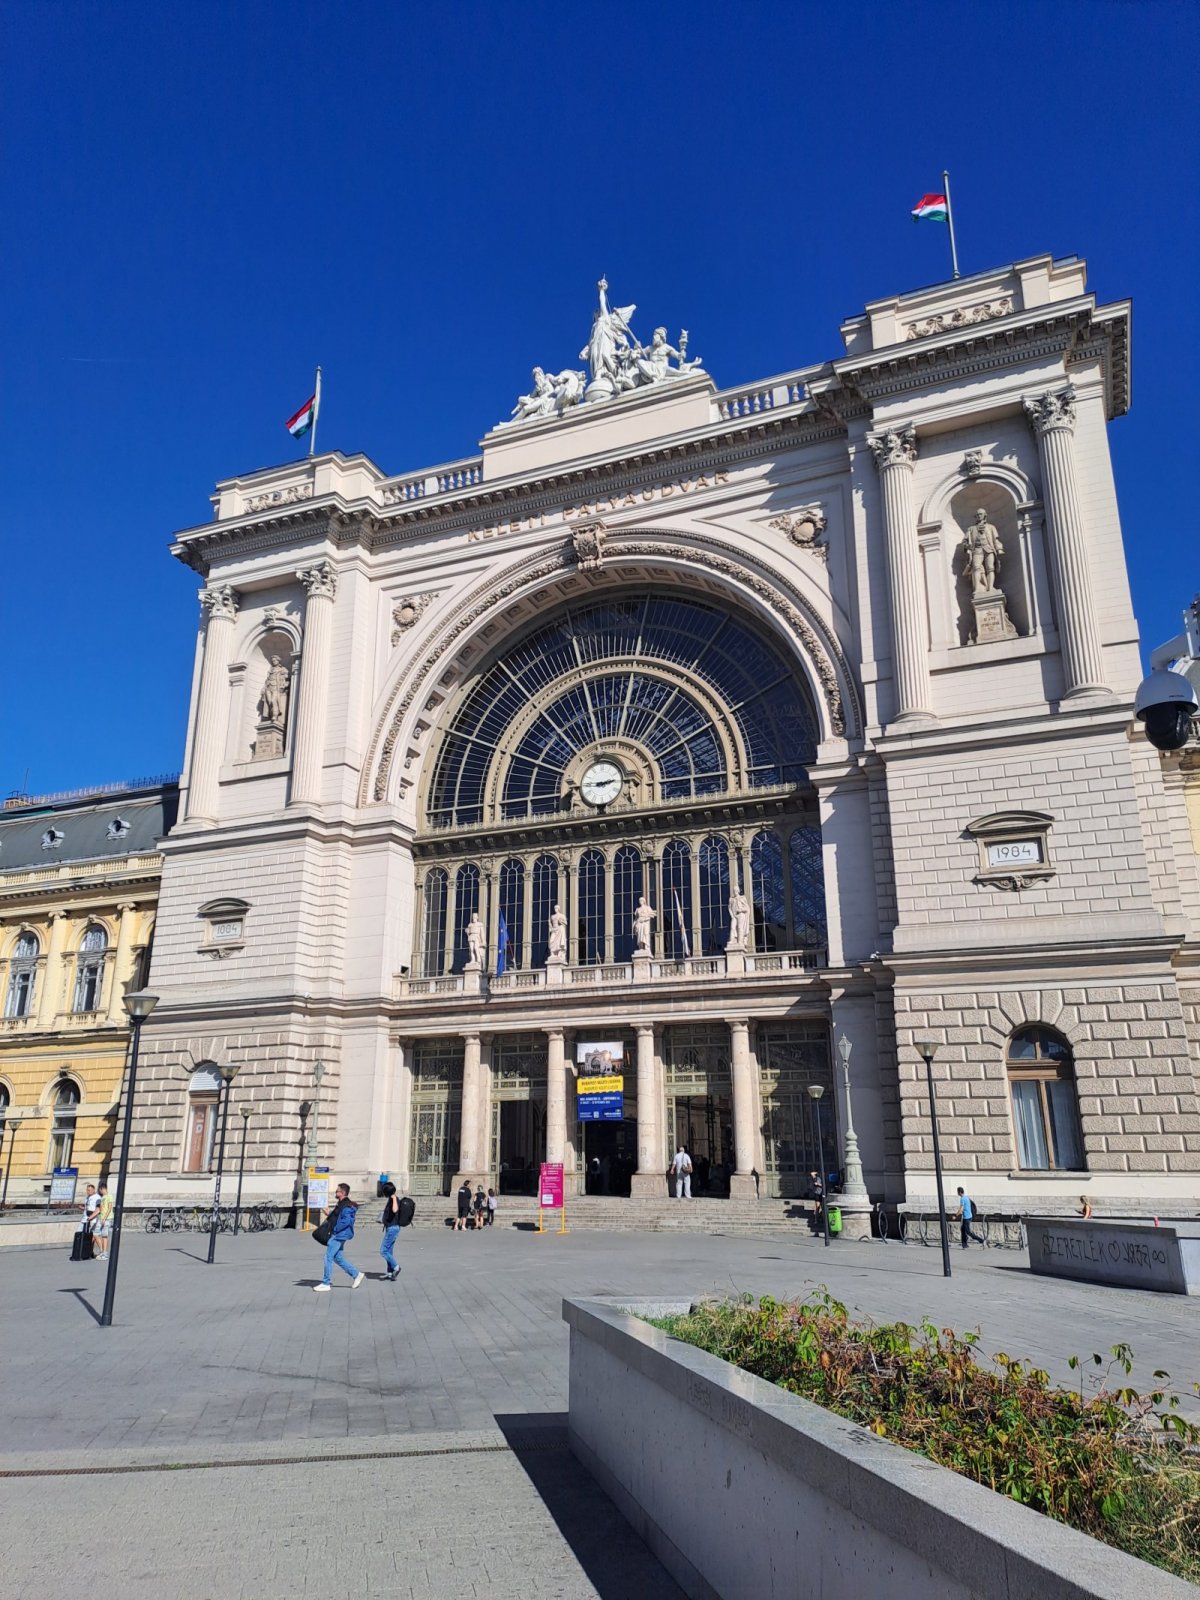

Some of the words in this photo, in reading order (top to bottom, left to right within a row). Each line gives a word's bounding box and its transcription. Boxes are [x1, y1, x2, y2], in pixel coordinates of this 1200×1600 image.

[468, 511, 545, 542] KELETI
[996, 845, 1030, 858] 1984
[1042, 1234, 1108, 1264] SZERETLEK
